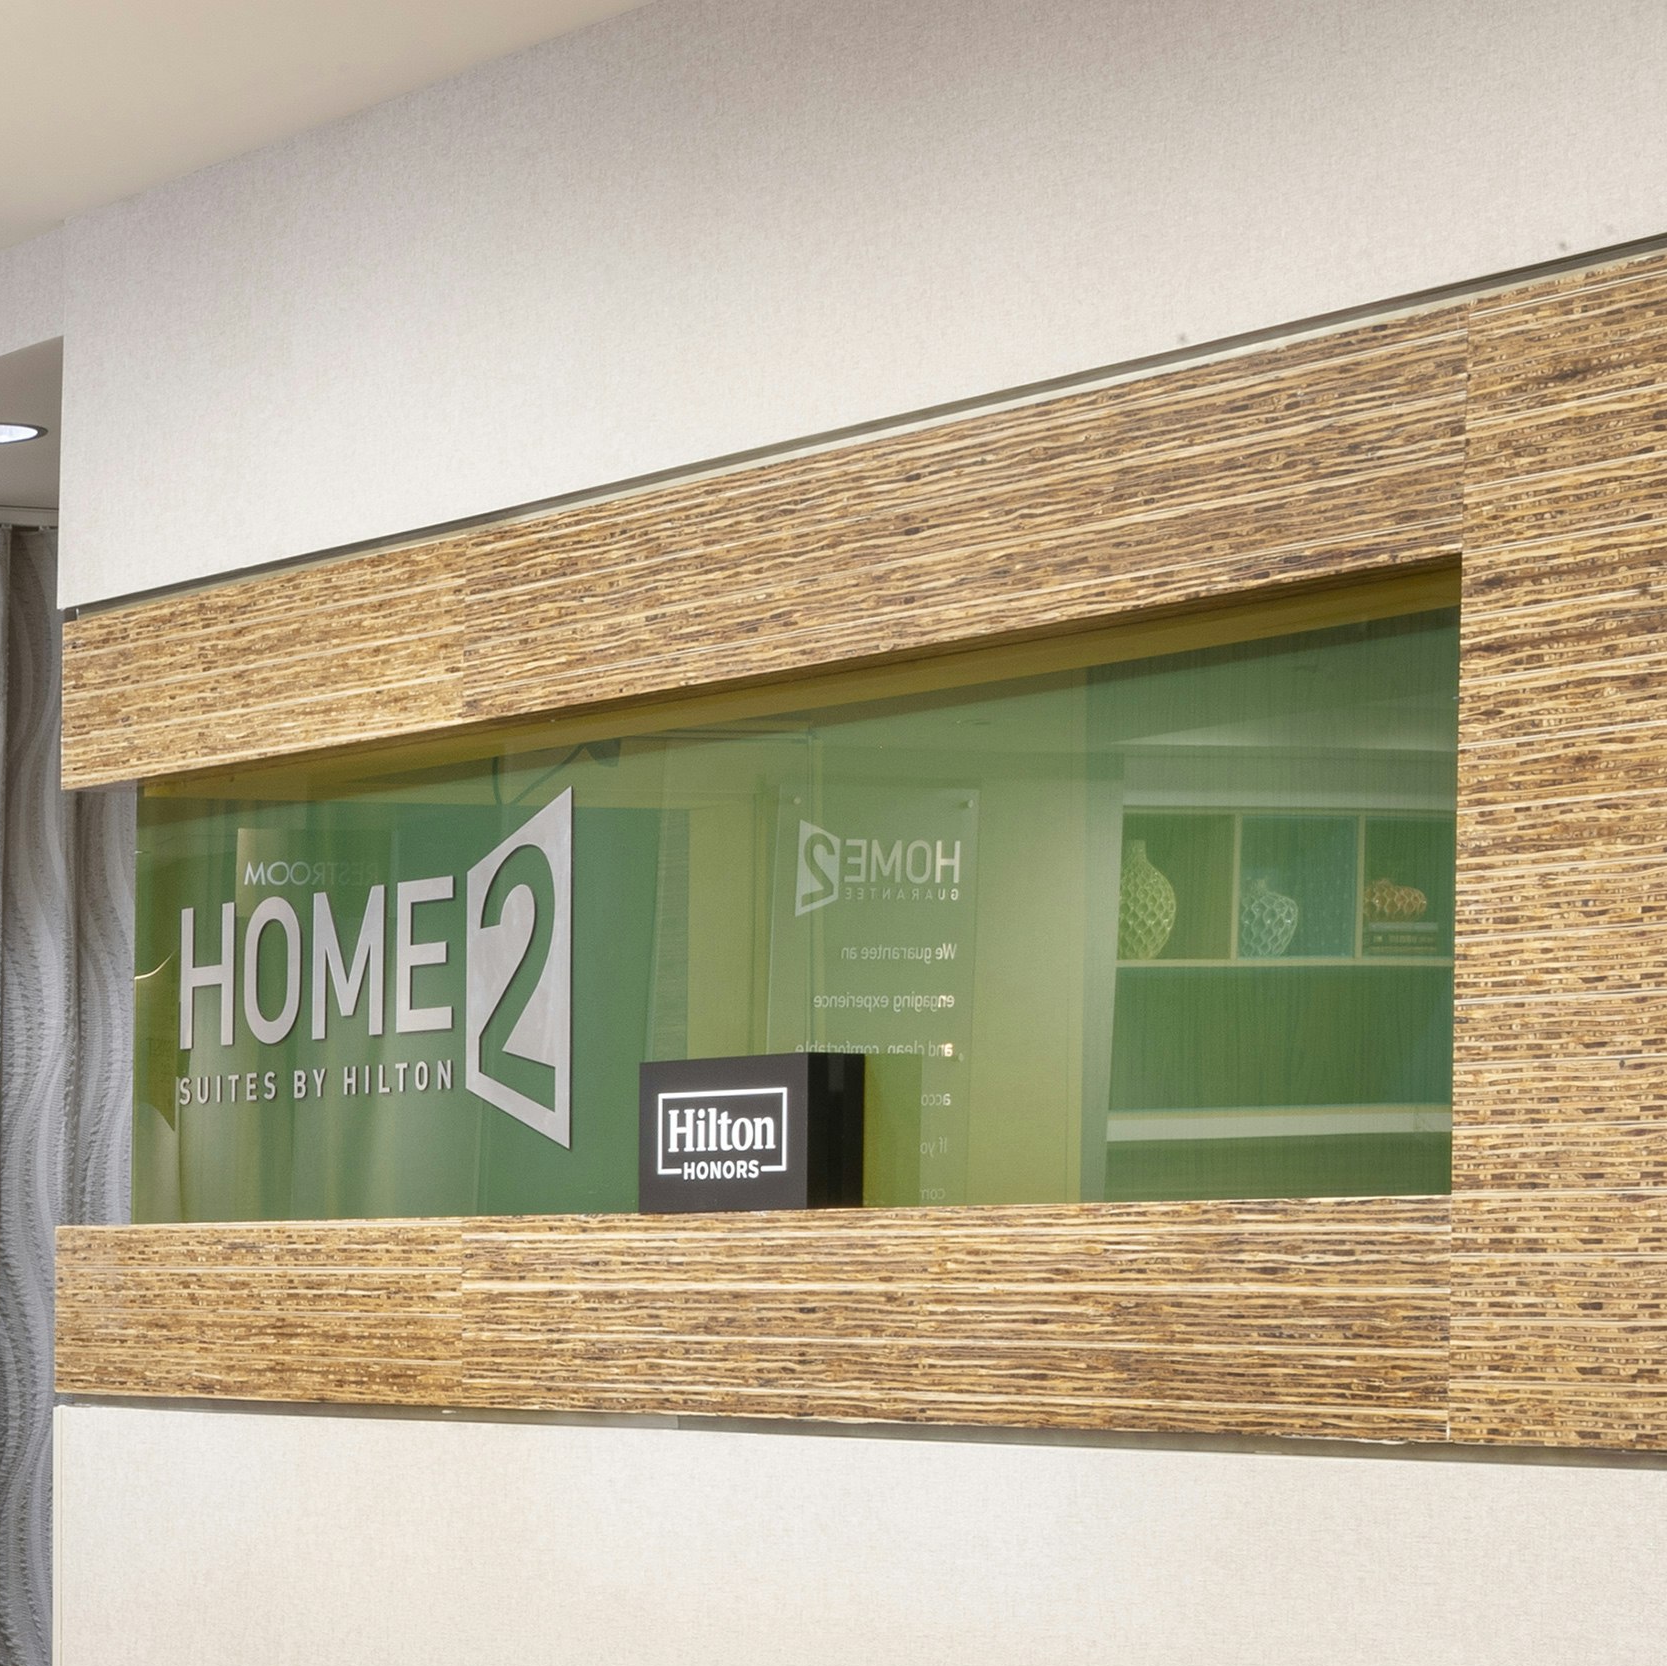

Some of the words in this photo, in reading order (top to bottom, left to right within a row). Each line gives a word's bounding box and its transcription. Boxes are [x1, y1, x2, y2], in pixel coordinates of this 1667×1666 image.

[179, 1071, 276, 1105] SUITES
[294, 1067, 326, 1100] BY
[344, 1059, 453, 1096] HILTON
[667, 1106, 777, 1154] Hilton
[683, 1160, 759, 1181] HONORS
